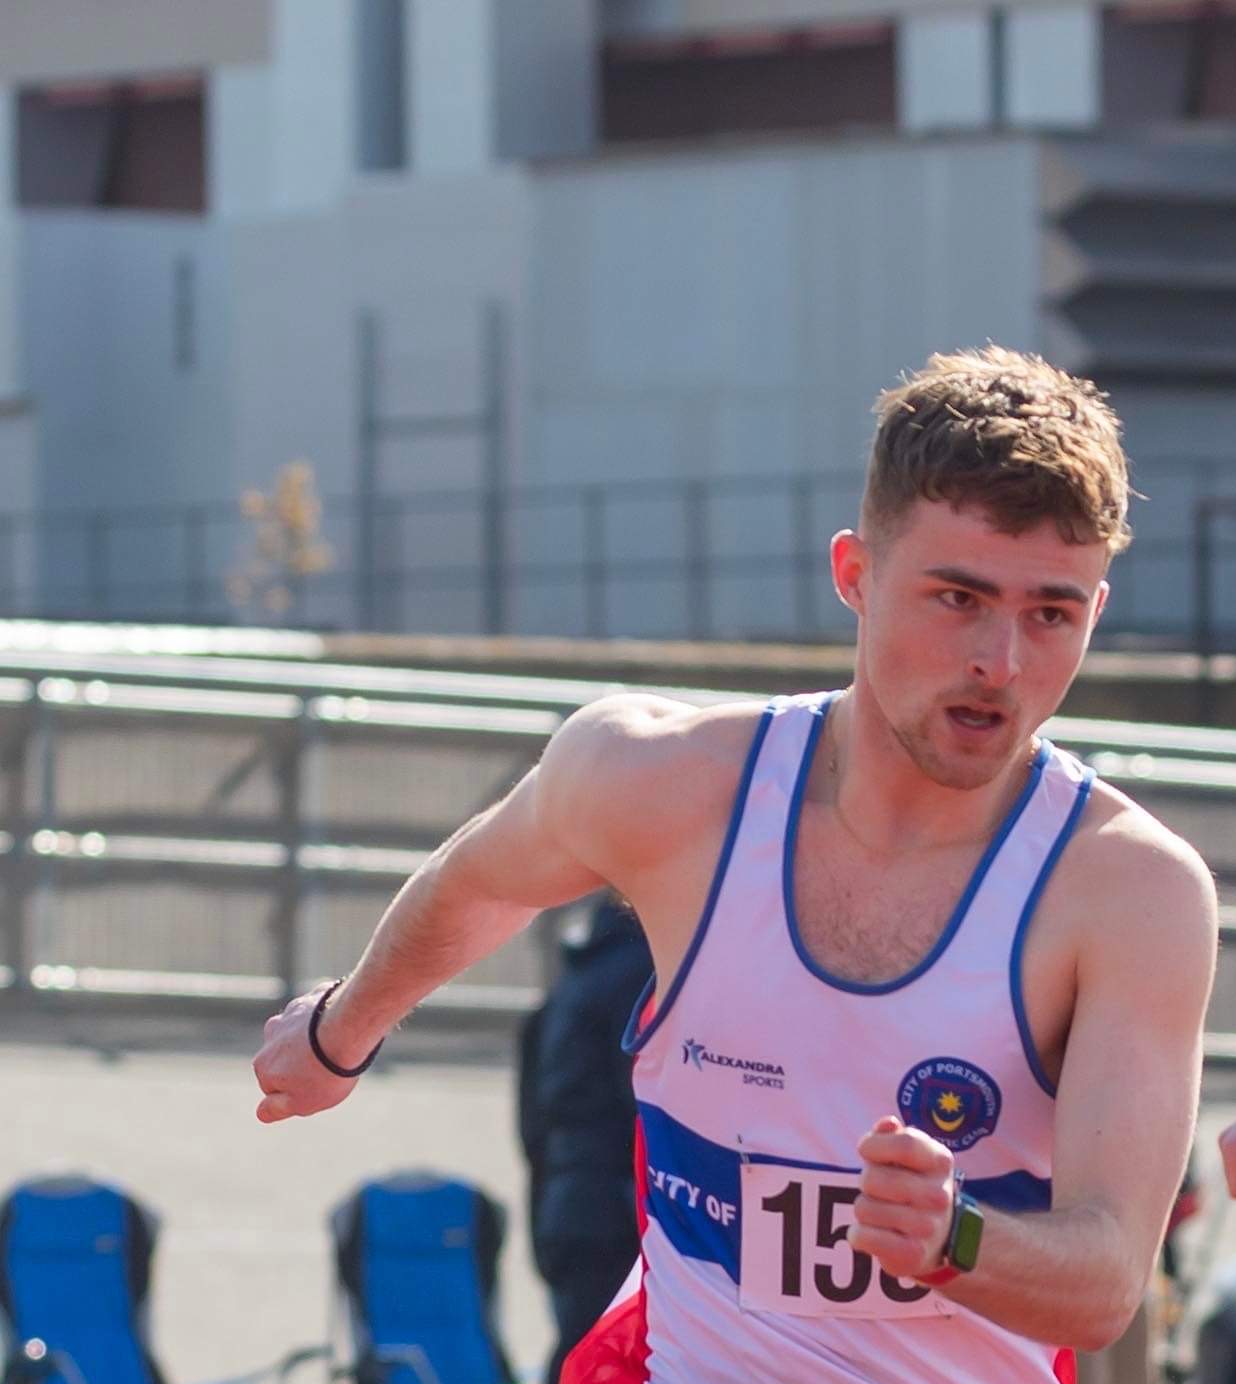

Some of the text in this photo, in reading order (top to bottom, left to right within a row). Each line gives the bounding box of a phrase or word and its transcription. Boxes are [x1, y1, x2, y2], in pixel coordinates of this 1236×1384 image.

[701, 1051, 785, 1076] ALEXANDRA
[743, 1073, 785, 1090] SPORTS
[901, 1075, 919, 1106] CITY
[917, 1064, 933, 1080] OF
[705, 1194, 737, 1226] OF
